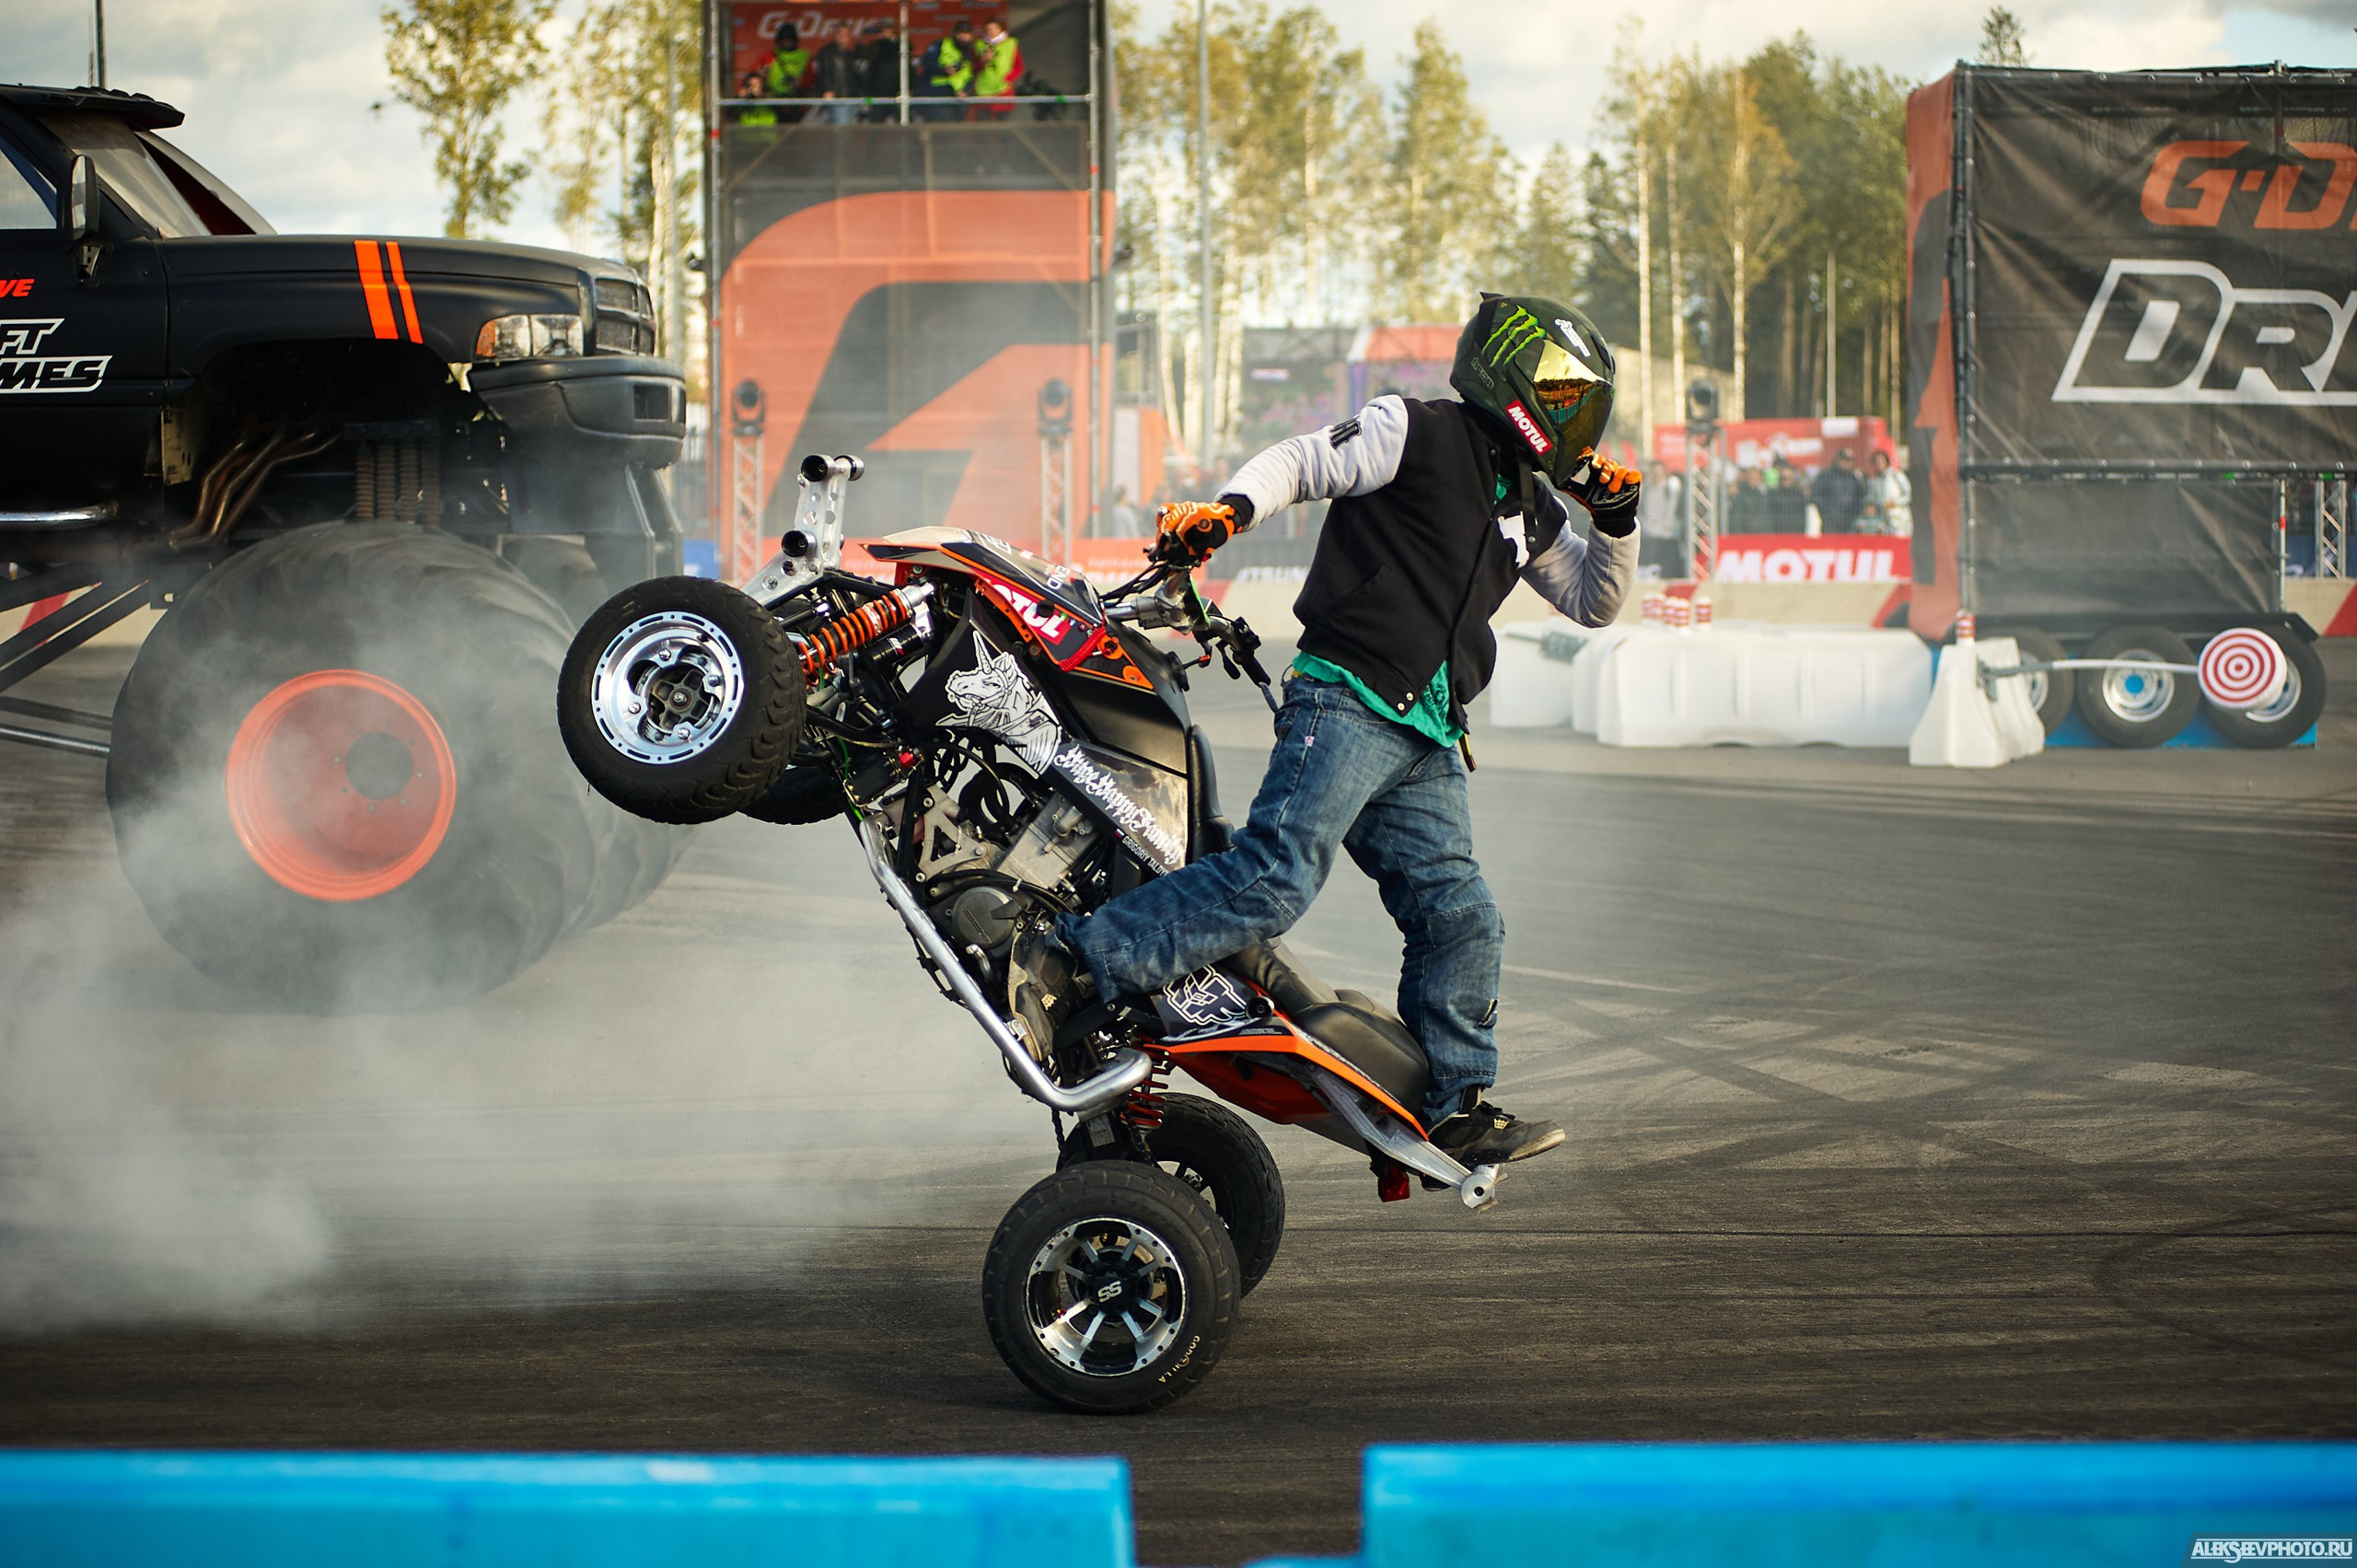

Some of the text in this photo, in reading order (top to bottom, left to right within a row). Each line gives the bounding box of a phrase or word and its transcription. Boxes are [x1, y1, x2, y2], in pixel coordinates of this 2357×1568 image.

[2141, 140, 2357, 231] G-D
[2050, 258, 2357, 406] DR
[1507, 404, 1549, 453] MOTUL
[1713, 548, 1906, 584] MOTUL
[984, 577, 1061, 639] OTUL
[1146, 856, 1168, 877] TALDY
[1097, 1280, 1122, 1303] SS
